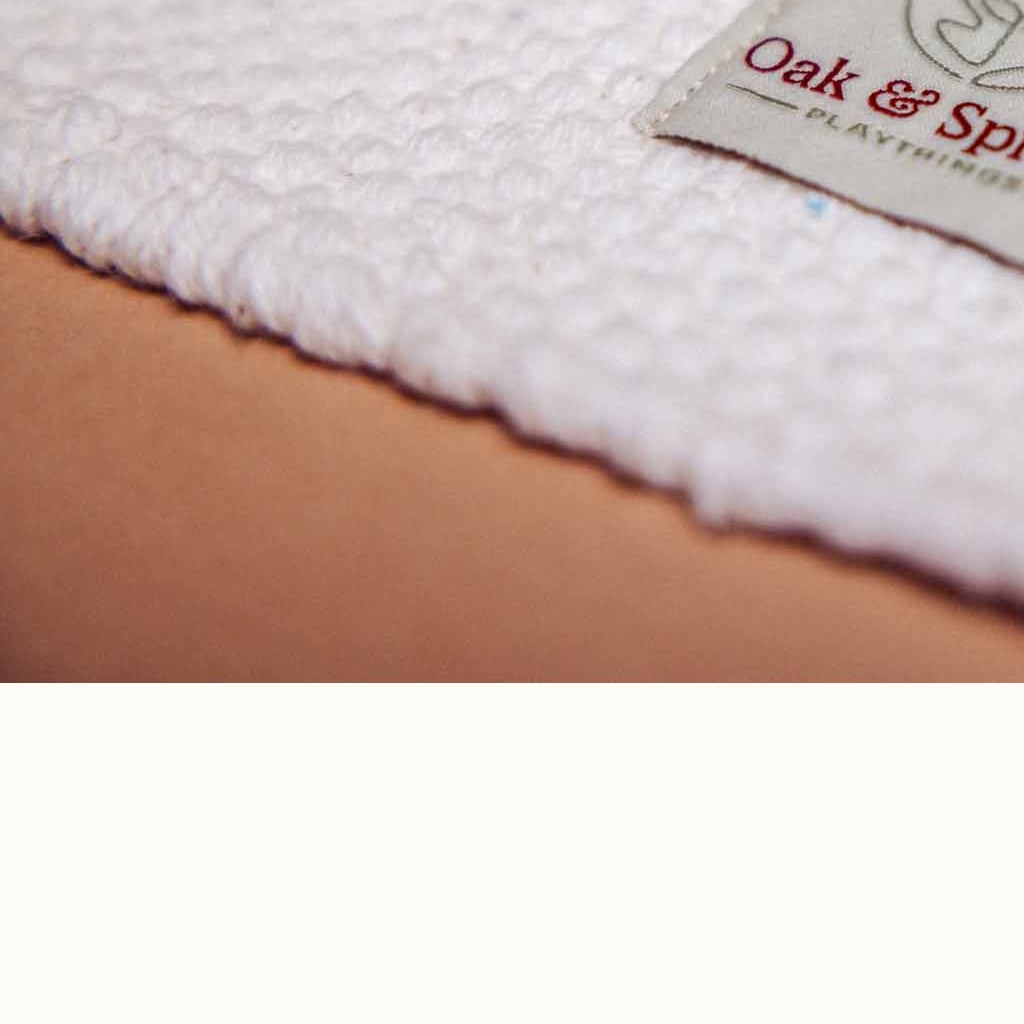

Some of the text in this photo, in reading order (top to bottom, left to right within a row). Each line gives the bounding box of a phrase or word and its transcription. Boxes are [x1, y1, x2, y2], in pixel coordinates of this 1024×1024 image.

[744, 36, 861, 101] Oak
[867, 79, 941, 118] &
[805, 107, 1023, 192] PLAYTHINGS
